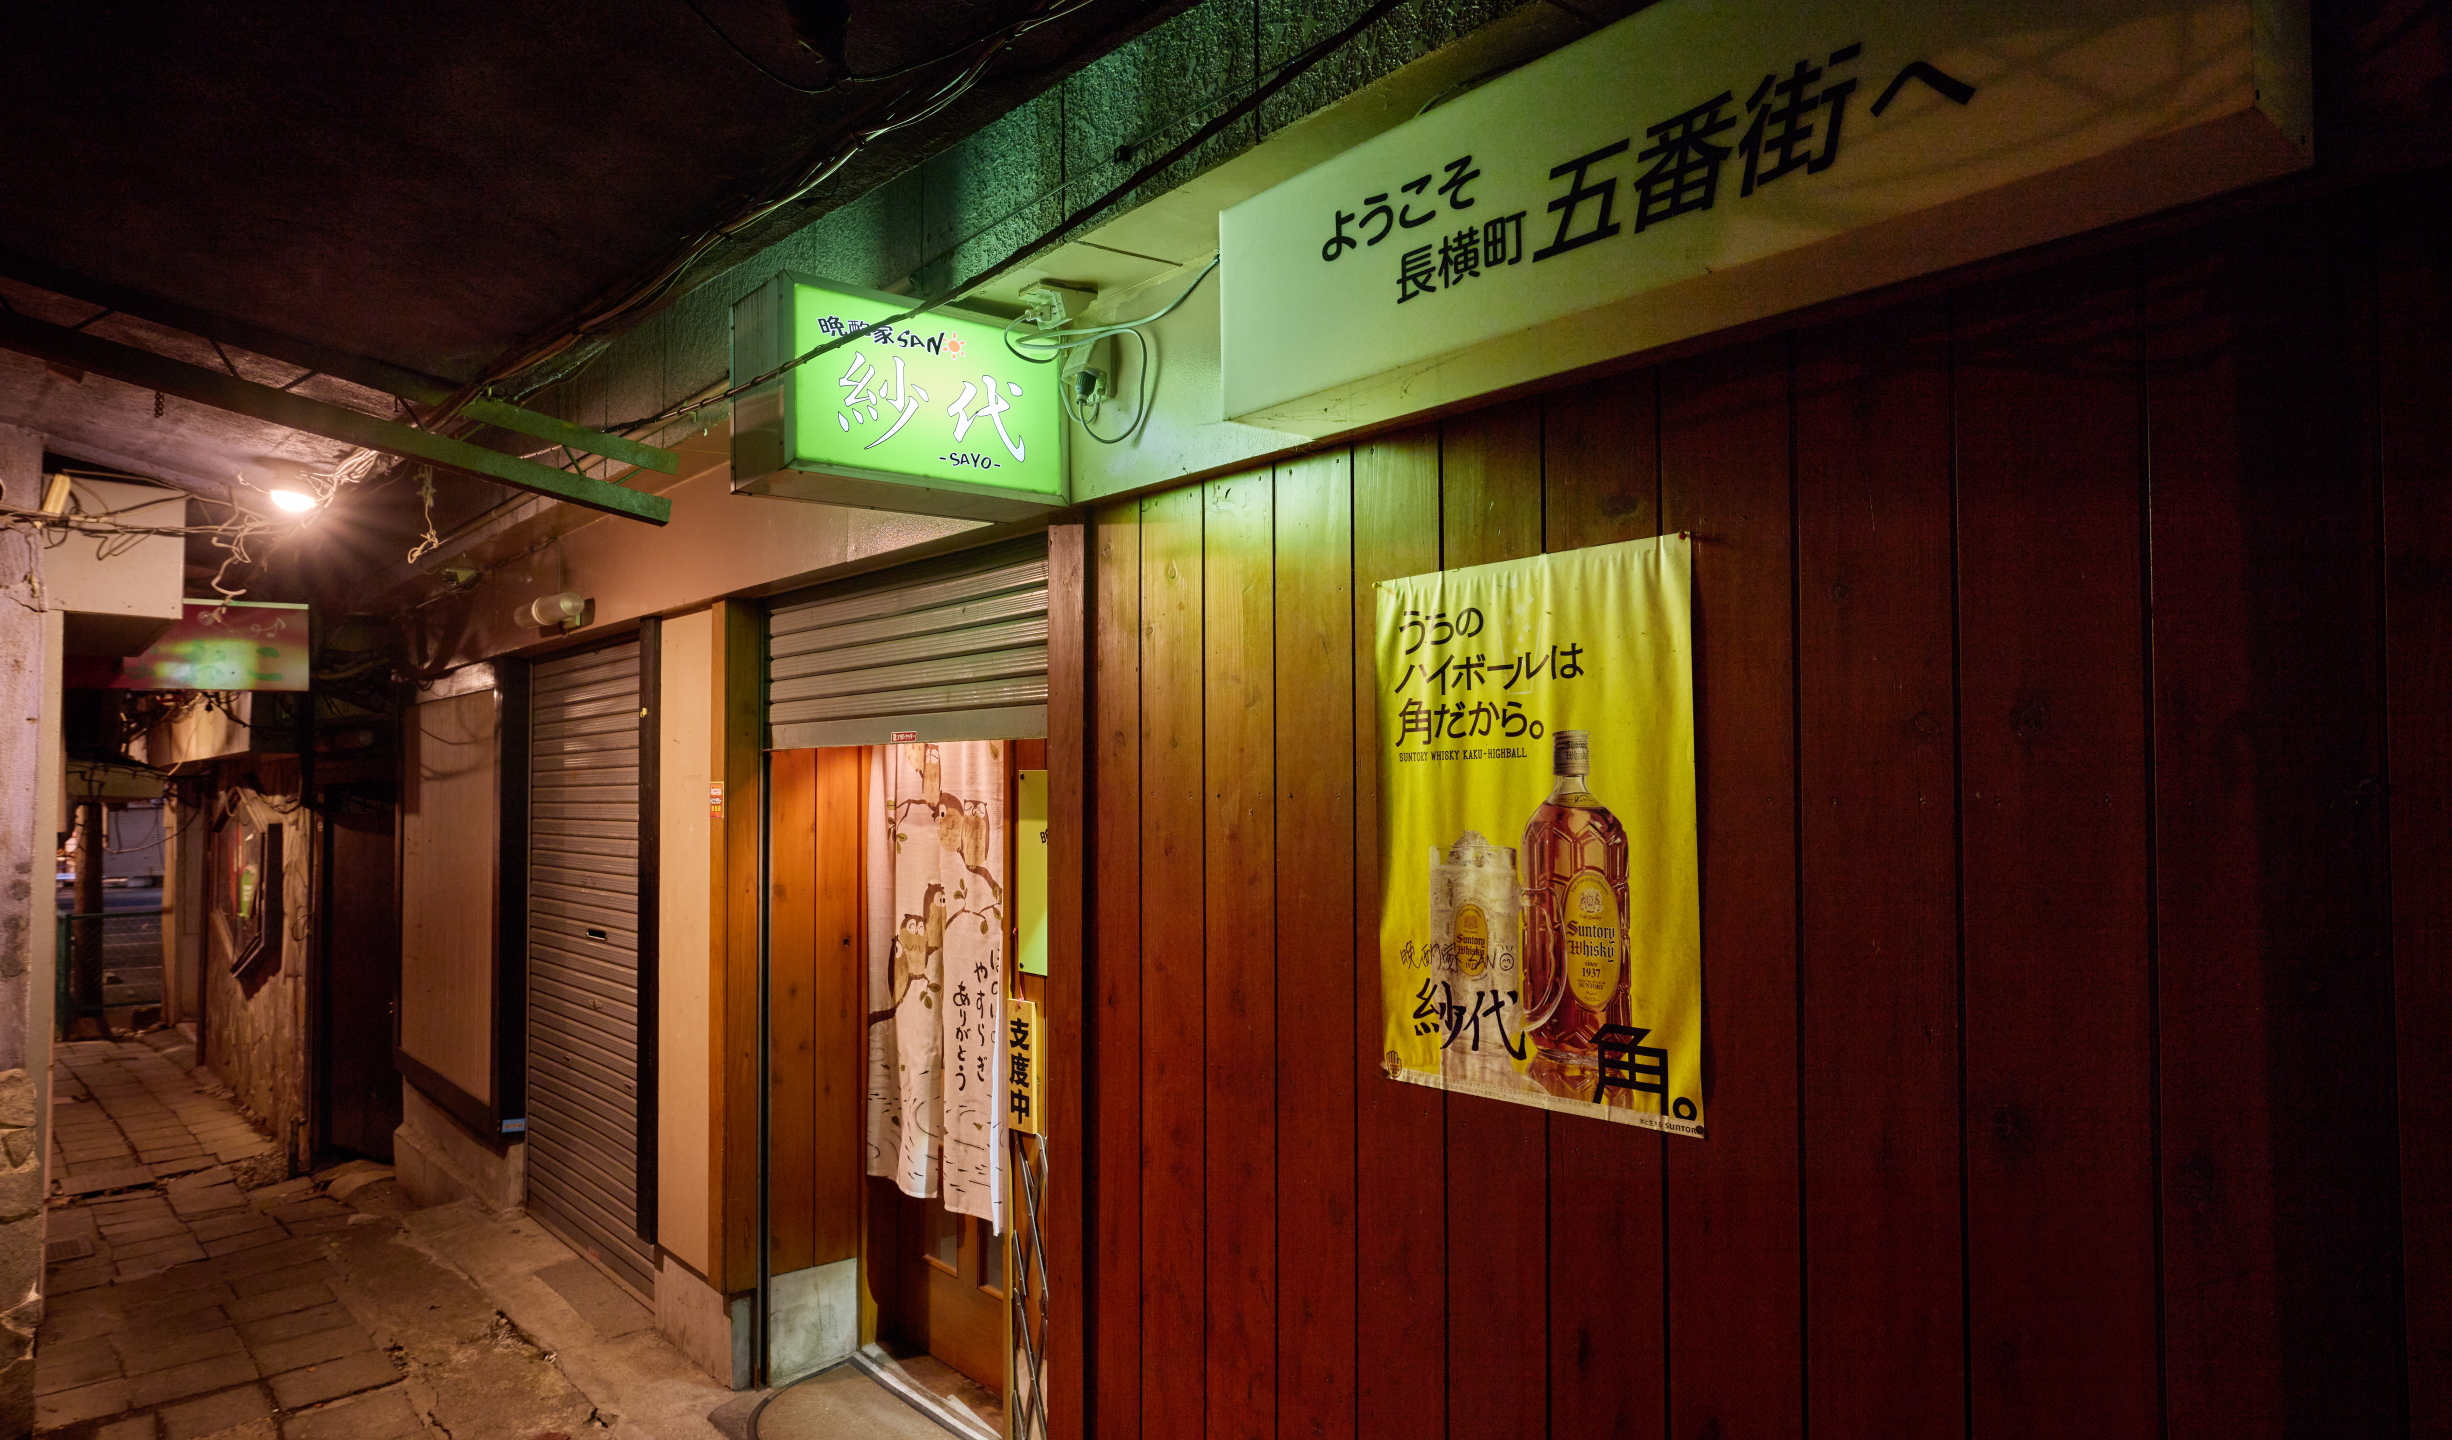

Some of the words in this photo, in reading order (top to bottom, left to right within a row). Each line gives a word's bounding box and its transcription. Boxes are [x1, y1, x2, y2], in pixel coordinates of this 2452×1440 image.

[1397, 211, 1527, 305] 長横町
[1532, 42, 1976, 263] 五番街へ
[1321, 154, 1481, 262] ようこそ
[838, 351, 1025, 463] 紗代
[939, 452, 1001, 471] -SAYO-
[1399, 607, 1484, 656] うちの
[1394, 642, 1584, 696] ハイボールは
[1395, 697, 1545, 748] 角だから。
[1399, 751, 1428, 762] SUNTORY
[1431, 749, 1460, 761] WHISKY
[1463, 747, 1528, 760] KAKU-HIGHBALL
[1566, 920, 1615, 944] Suntory
[1567, 940, 1614, 963] Whisky
[1582, 967, 1601, 979] 1937
[953, 981, 971, 1091] ありがとう
[973, 961, 988, 1082] やすらぎ
[1413, 977, 1527, 1060] 紗代
[1009, 1018, 1030, 1124] 支度中
[1665, 1121, 1703, 1135] SUNTOR
